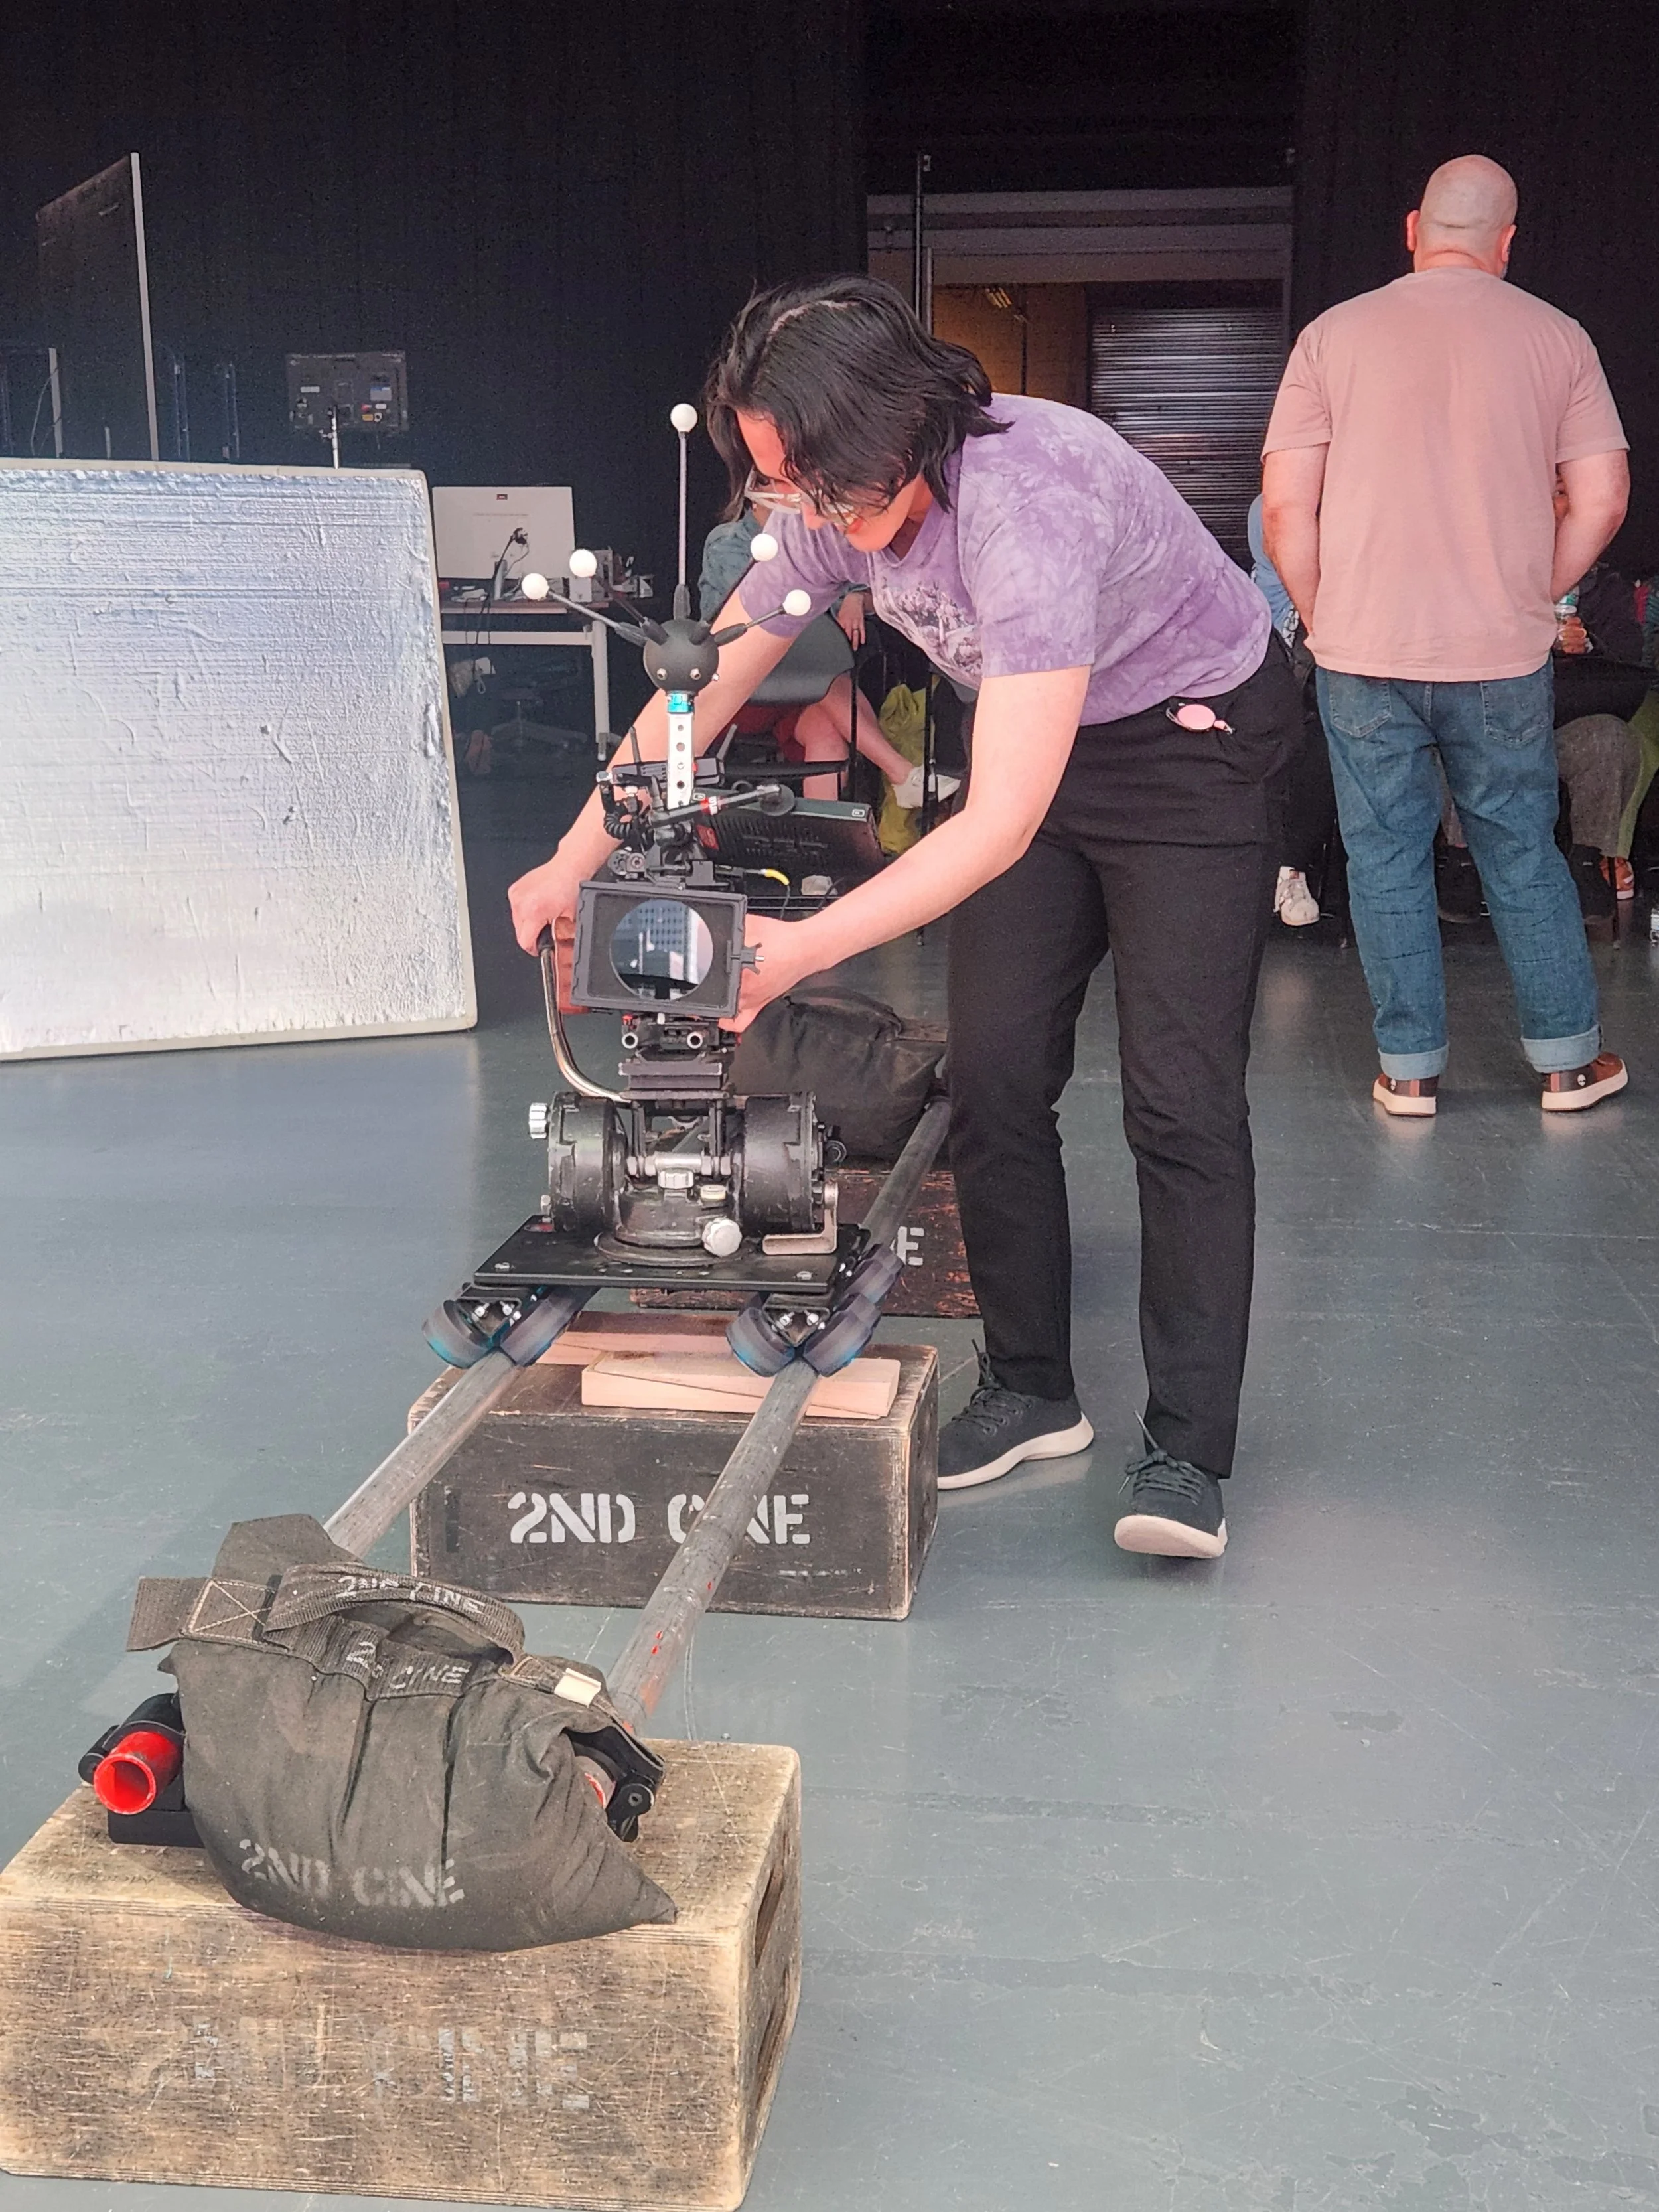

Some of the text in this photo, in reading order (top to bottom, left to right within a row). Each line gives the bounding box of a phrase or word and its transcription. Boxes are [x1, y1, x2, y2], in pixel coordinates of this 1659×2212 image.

[508, 1491, 810, 1544] 2ND CNE
[390, 1664, 470, 1690] CINE
[239, 1838, 465, 1907] 2ND CINE
